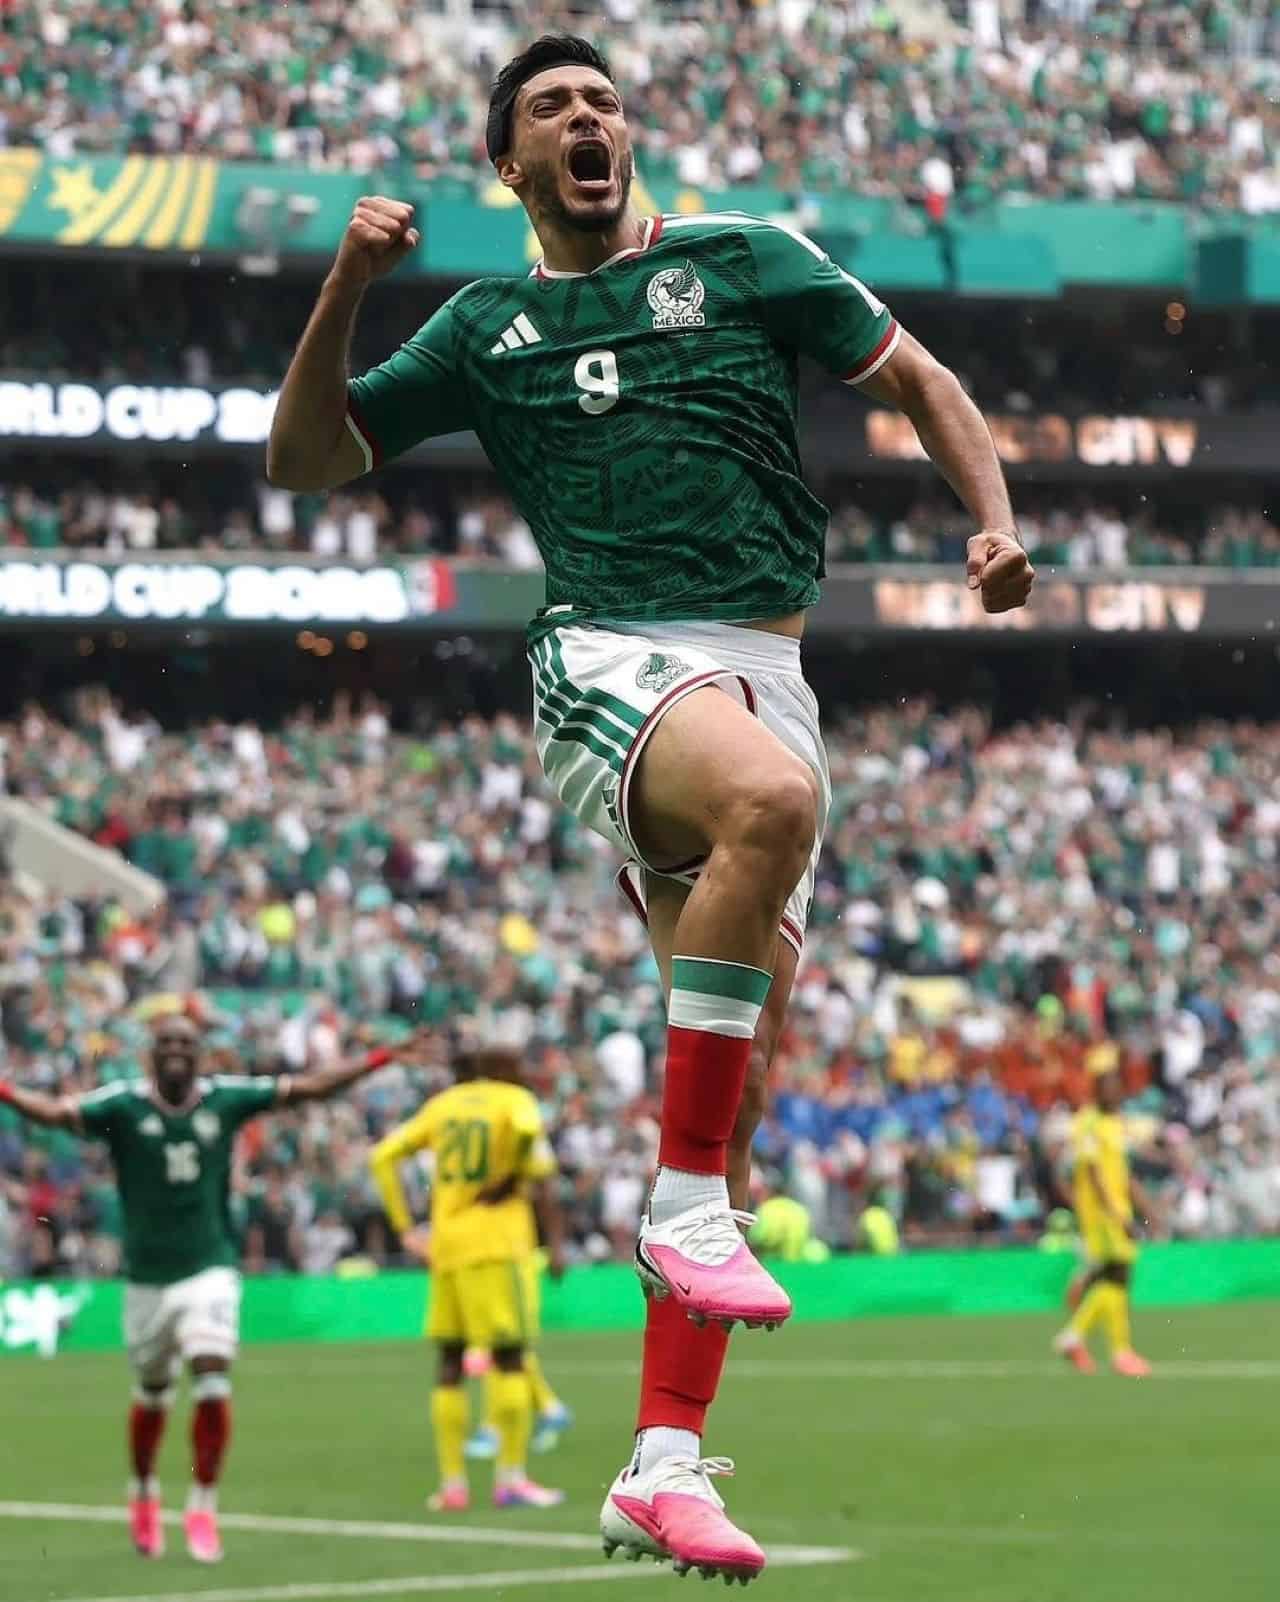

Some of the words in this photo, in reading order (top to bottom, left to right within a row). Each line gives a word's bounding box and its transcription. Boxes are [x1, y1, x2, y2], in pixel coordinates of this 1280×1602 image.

[574, 350, 619, 414] 9
[104, 385, 217, 440] CUP
[1076, 414, 1196, 467] CITY
[112, 565, 224, 618] CUP
[225, 567, 409, 622] 2026
[1086, 581, 1206, 632] CITY
[438, 1118, 489, 1182] 20
